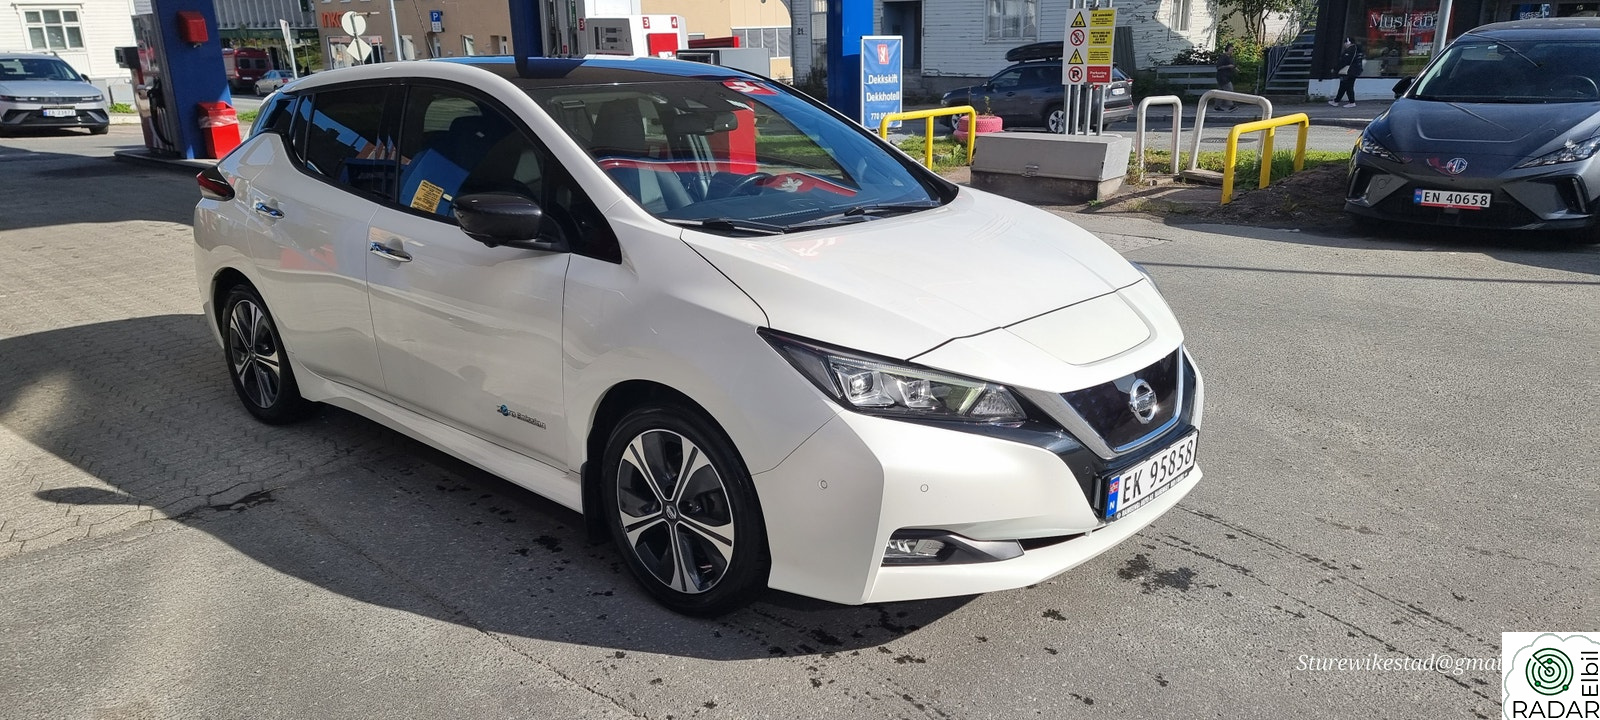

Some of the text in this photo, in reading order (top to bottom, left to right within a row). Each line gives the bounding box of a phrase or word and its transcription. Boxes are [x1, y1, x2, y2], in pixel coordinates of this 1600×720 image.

[643, 17, 650, 27] 3
[671, 17, 677, 27] 4
[1369, 13, 1434, 29] Muskan
[868, 74, 898, 84] Dekkskift
[866, 91, 899, 101] Dekkhotell
[1424, 191, 1488, 206] EN 40658
[1123, 469, 1143, 503] EK
[1150, 440, 1193, 489] 95858
[1109, 500, 1115, 511] N
